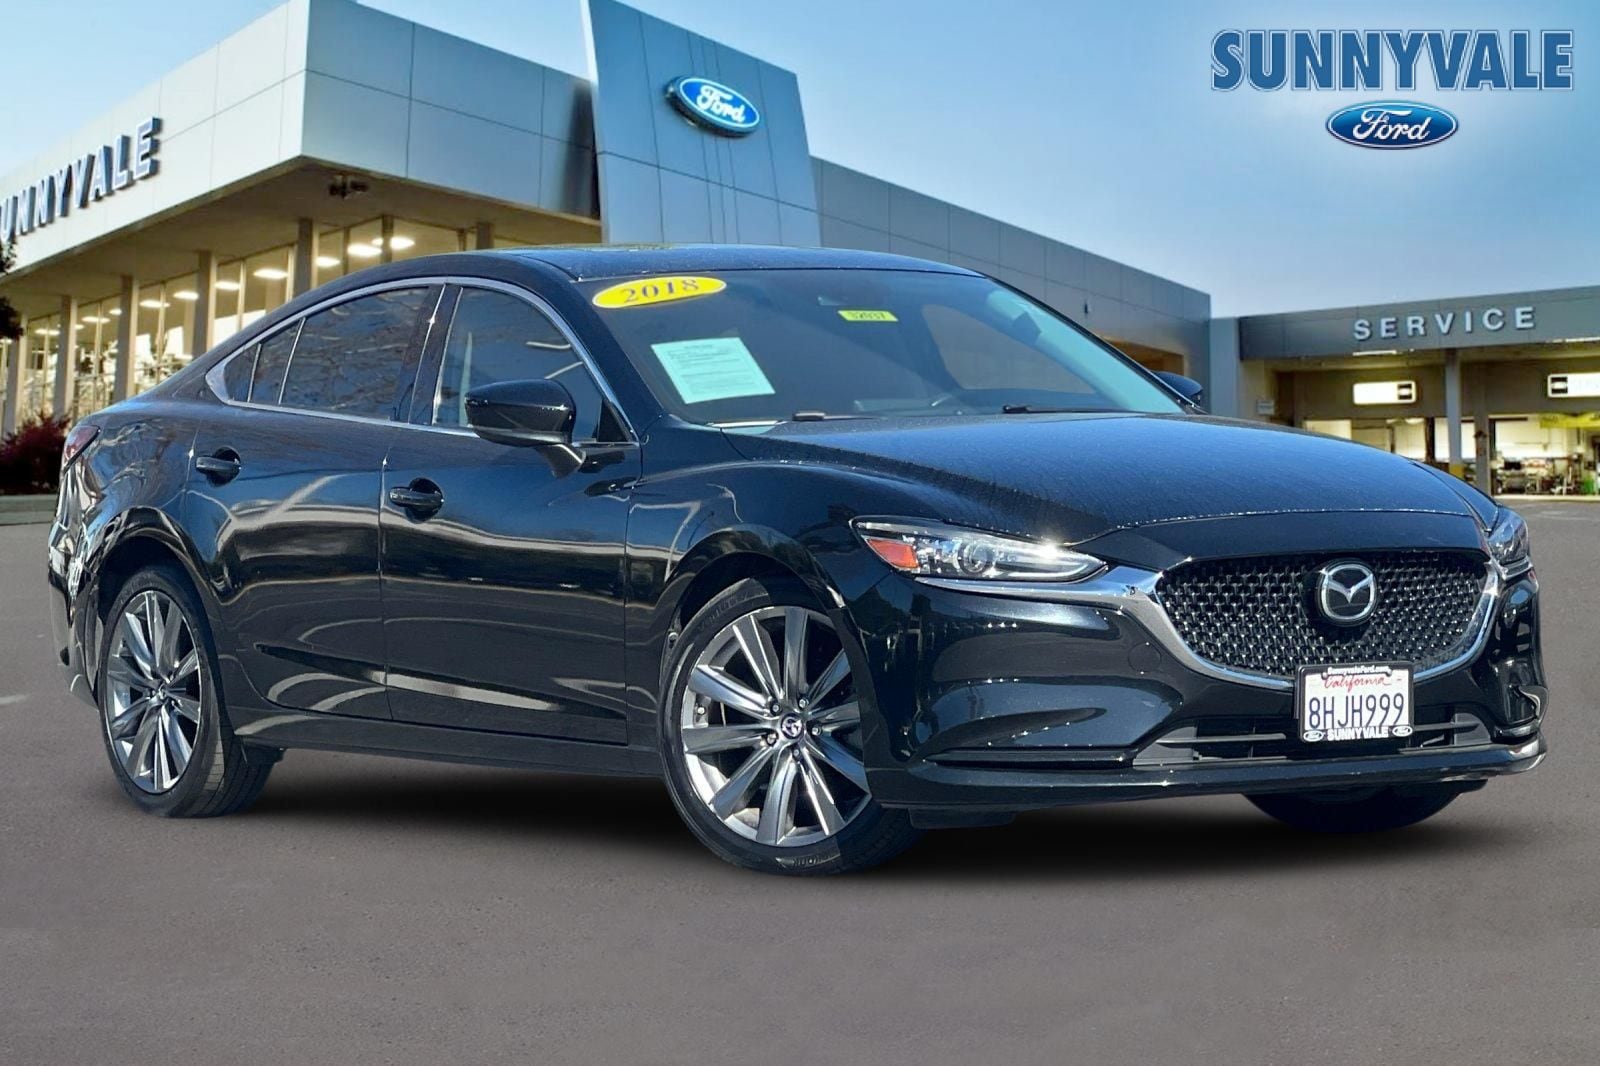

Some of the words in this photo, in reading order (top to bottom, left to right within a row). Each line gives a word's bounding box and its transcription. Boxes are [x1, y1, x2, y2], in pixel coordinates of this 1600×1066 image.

[696, 84, 746, 124] Ford
[0, 116, 162, 244] UNNYVALE
[620, 279, 699, 304] 2018
[1354, 306, 1536, 341] SERVICE
[1323, 674, 1392, 693] California
[1309, 692, 1405, 729] 8HJH999
[1327, 726, 1389, 741] SUNNYVALE
